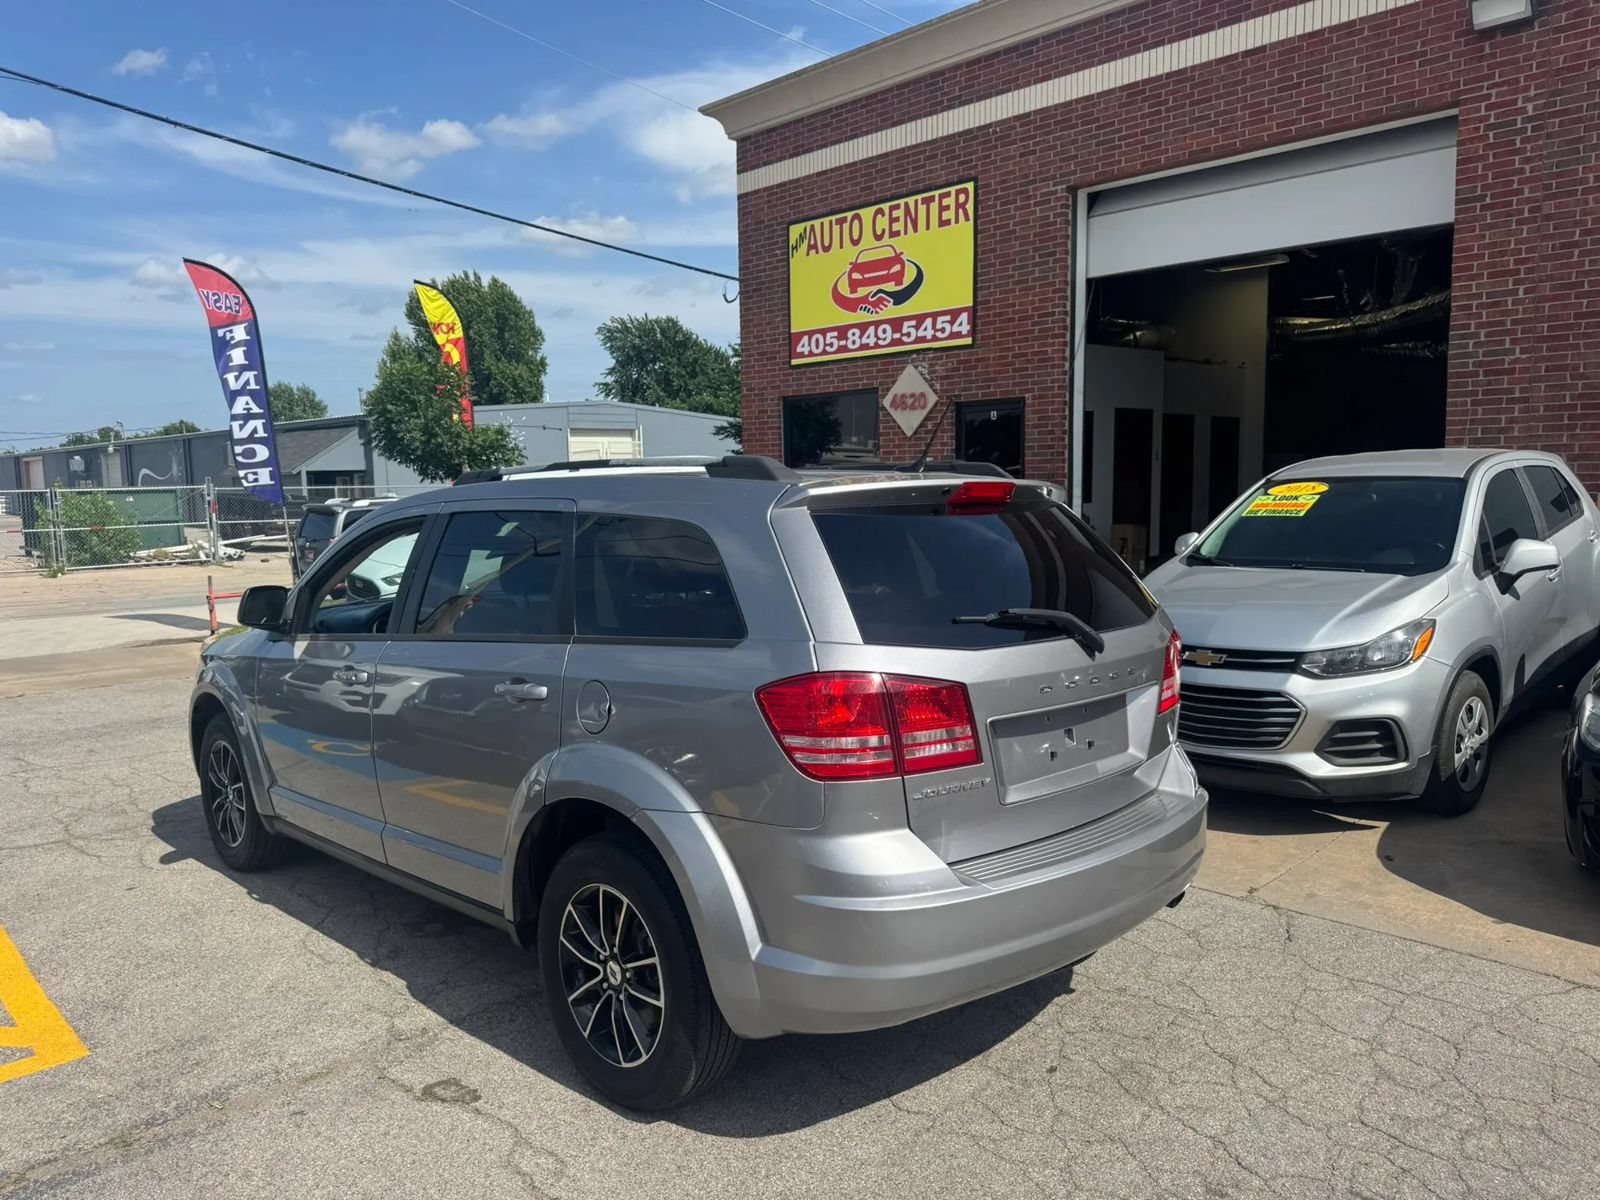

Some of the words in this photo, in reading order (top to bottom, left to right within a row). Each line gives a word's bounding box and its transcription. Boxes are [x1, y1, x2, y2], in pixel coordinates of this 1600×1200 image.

[805, 212, 863, 257] AUTO
[871, 187, 970, 242] CENTER
[791, 225, 807, 258] HM
[796, 312, 970, 355] 405-849-5454
[889, 391, 928, 411] 4620
[1040, 668, 1135, 694] DODGE
[912, 777, 991, 800] JOURNEY
